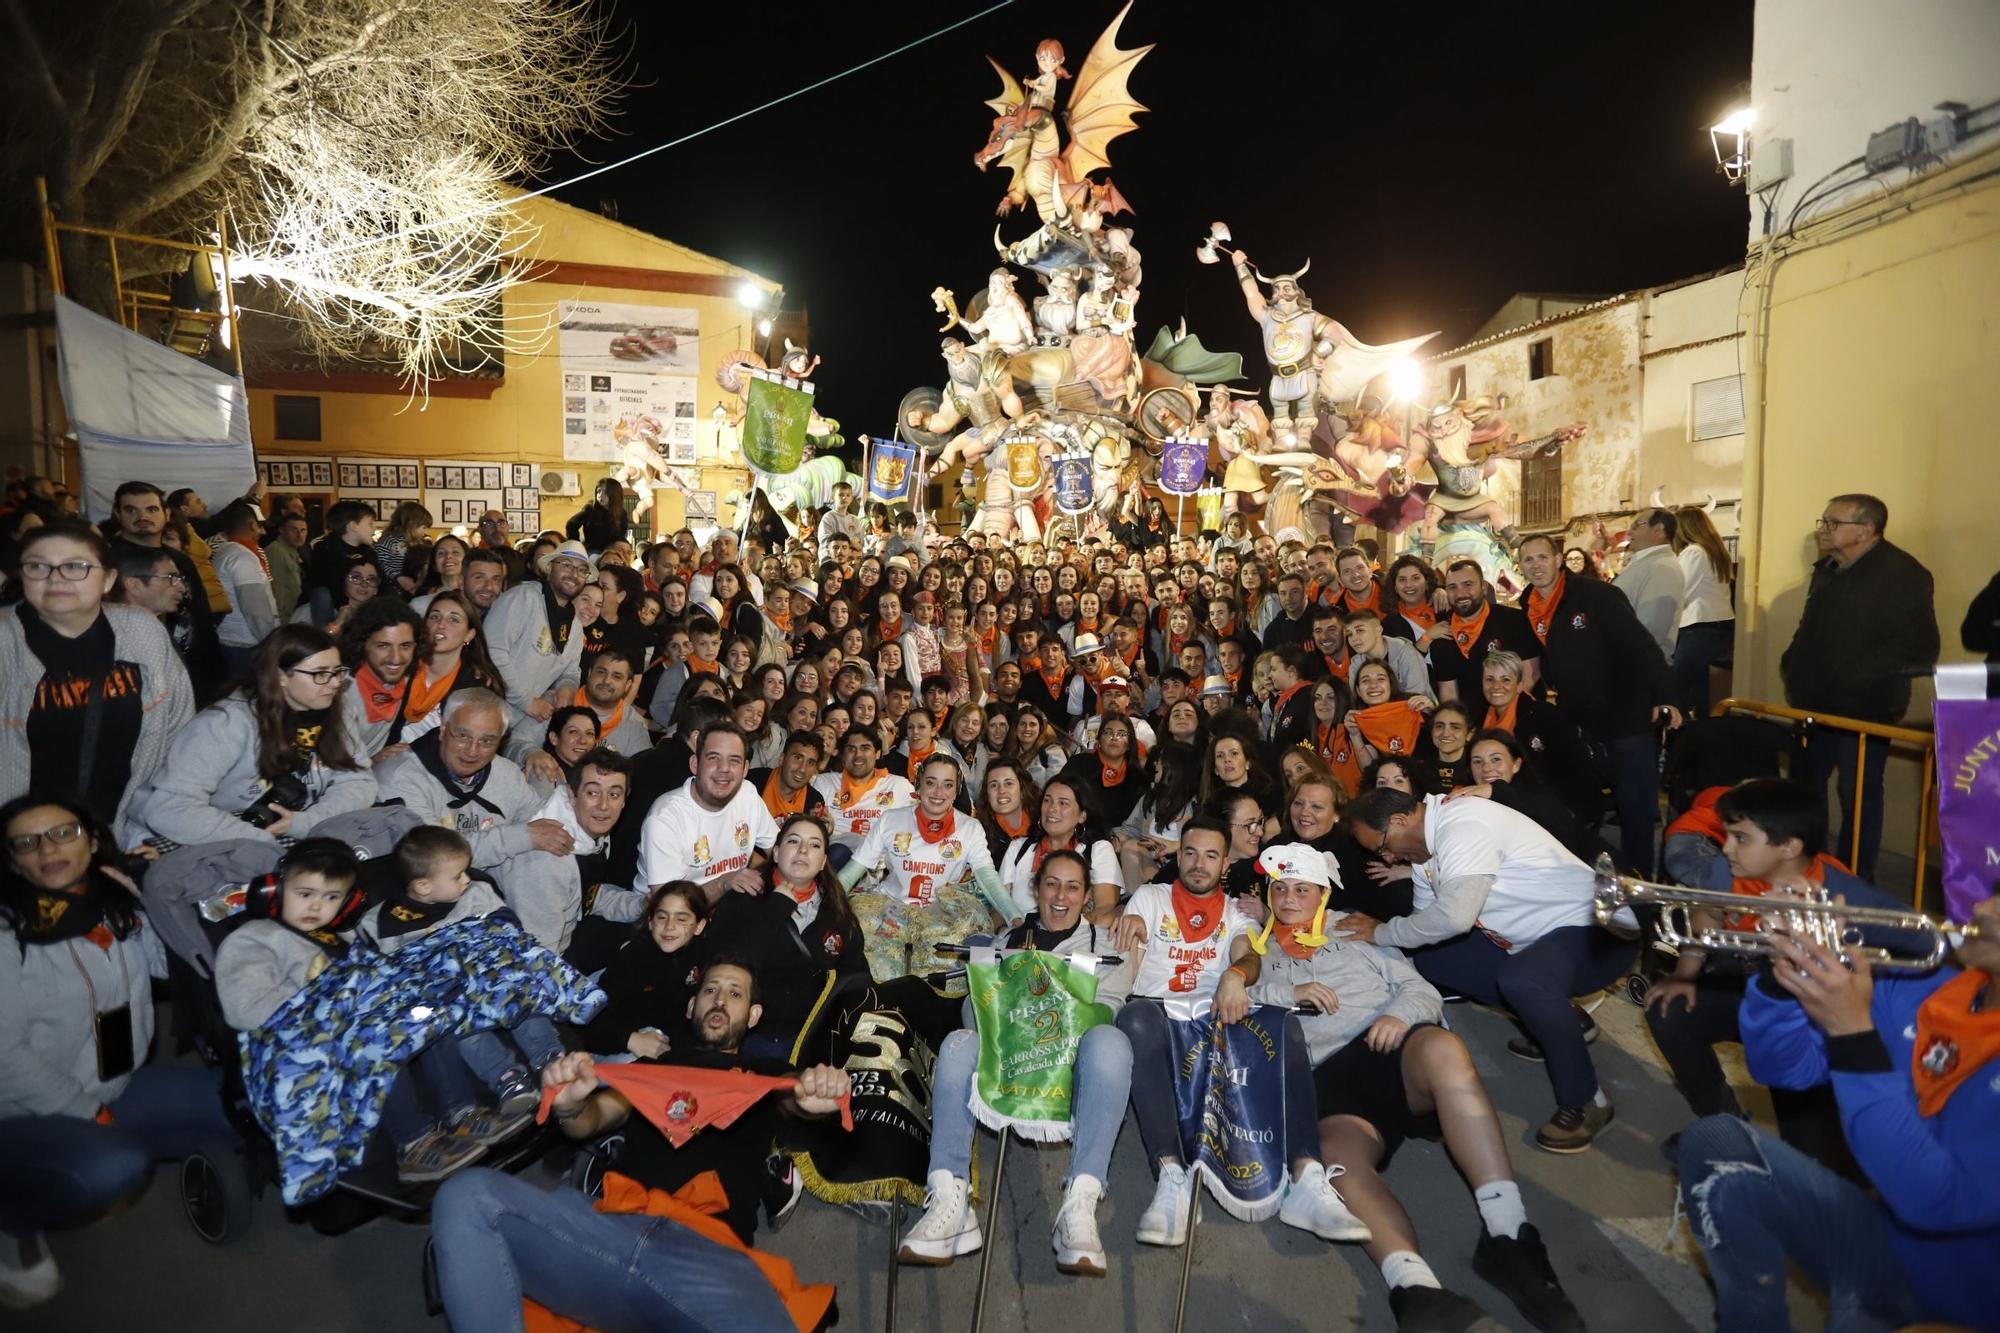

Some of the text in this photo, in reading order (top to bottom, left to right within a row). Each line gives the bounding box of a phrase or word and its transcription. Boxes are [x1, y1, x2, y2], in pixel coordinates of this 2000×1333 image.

[842, 809, 881, 819] CAMPIONS
[704, 853, 748, 877] CAMPIONS
[903, 860, 946, 875] CAMPIONS
[1168, 946, 1217, 963] CAMPONS
[1035, 1010, 1063, 1045] 2
[1181, 1040, 1208, 1081] JUNTA
[1241, 1018, 1276, 1062] ALLERA
[1008, 1058, 1053, 1079] Cavalcada
[849, 1071, 879, 1084] 973
[852, 1084, 886, 1097] 023
